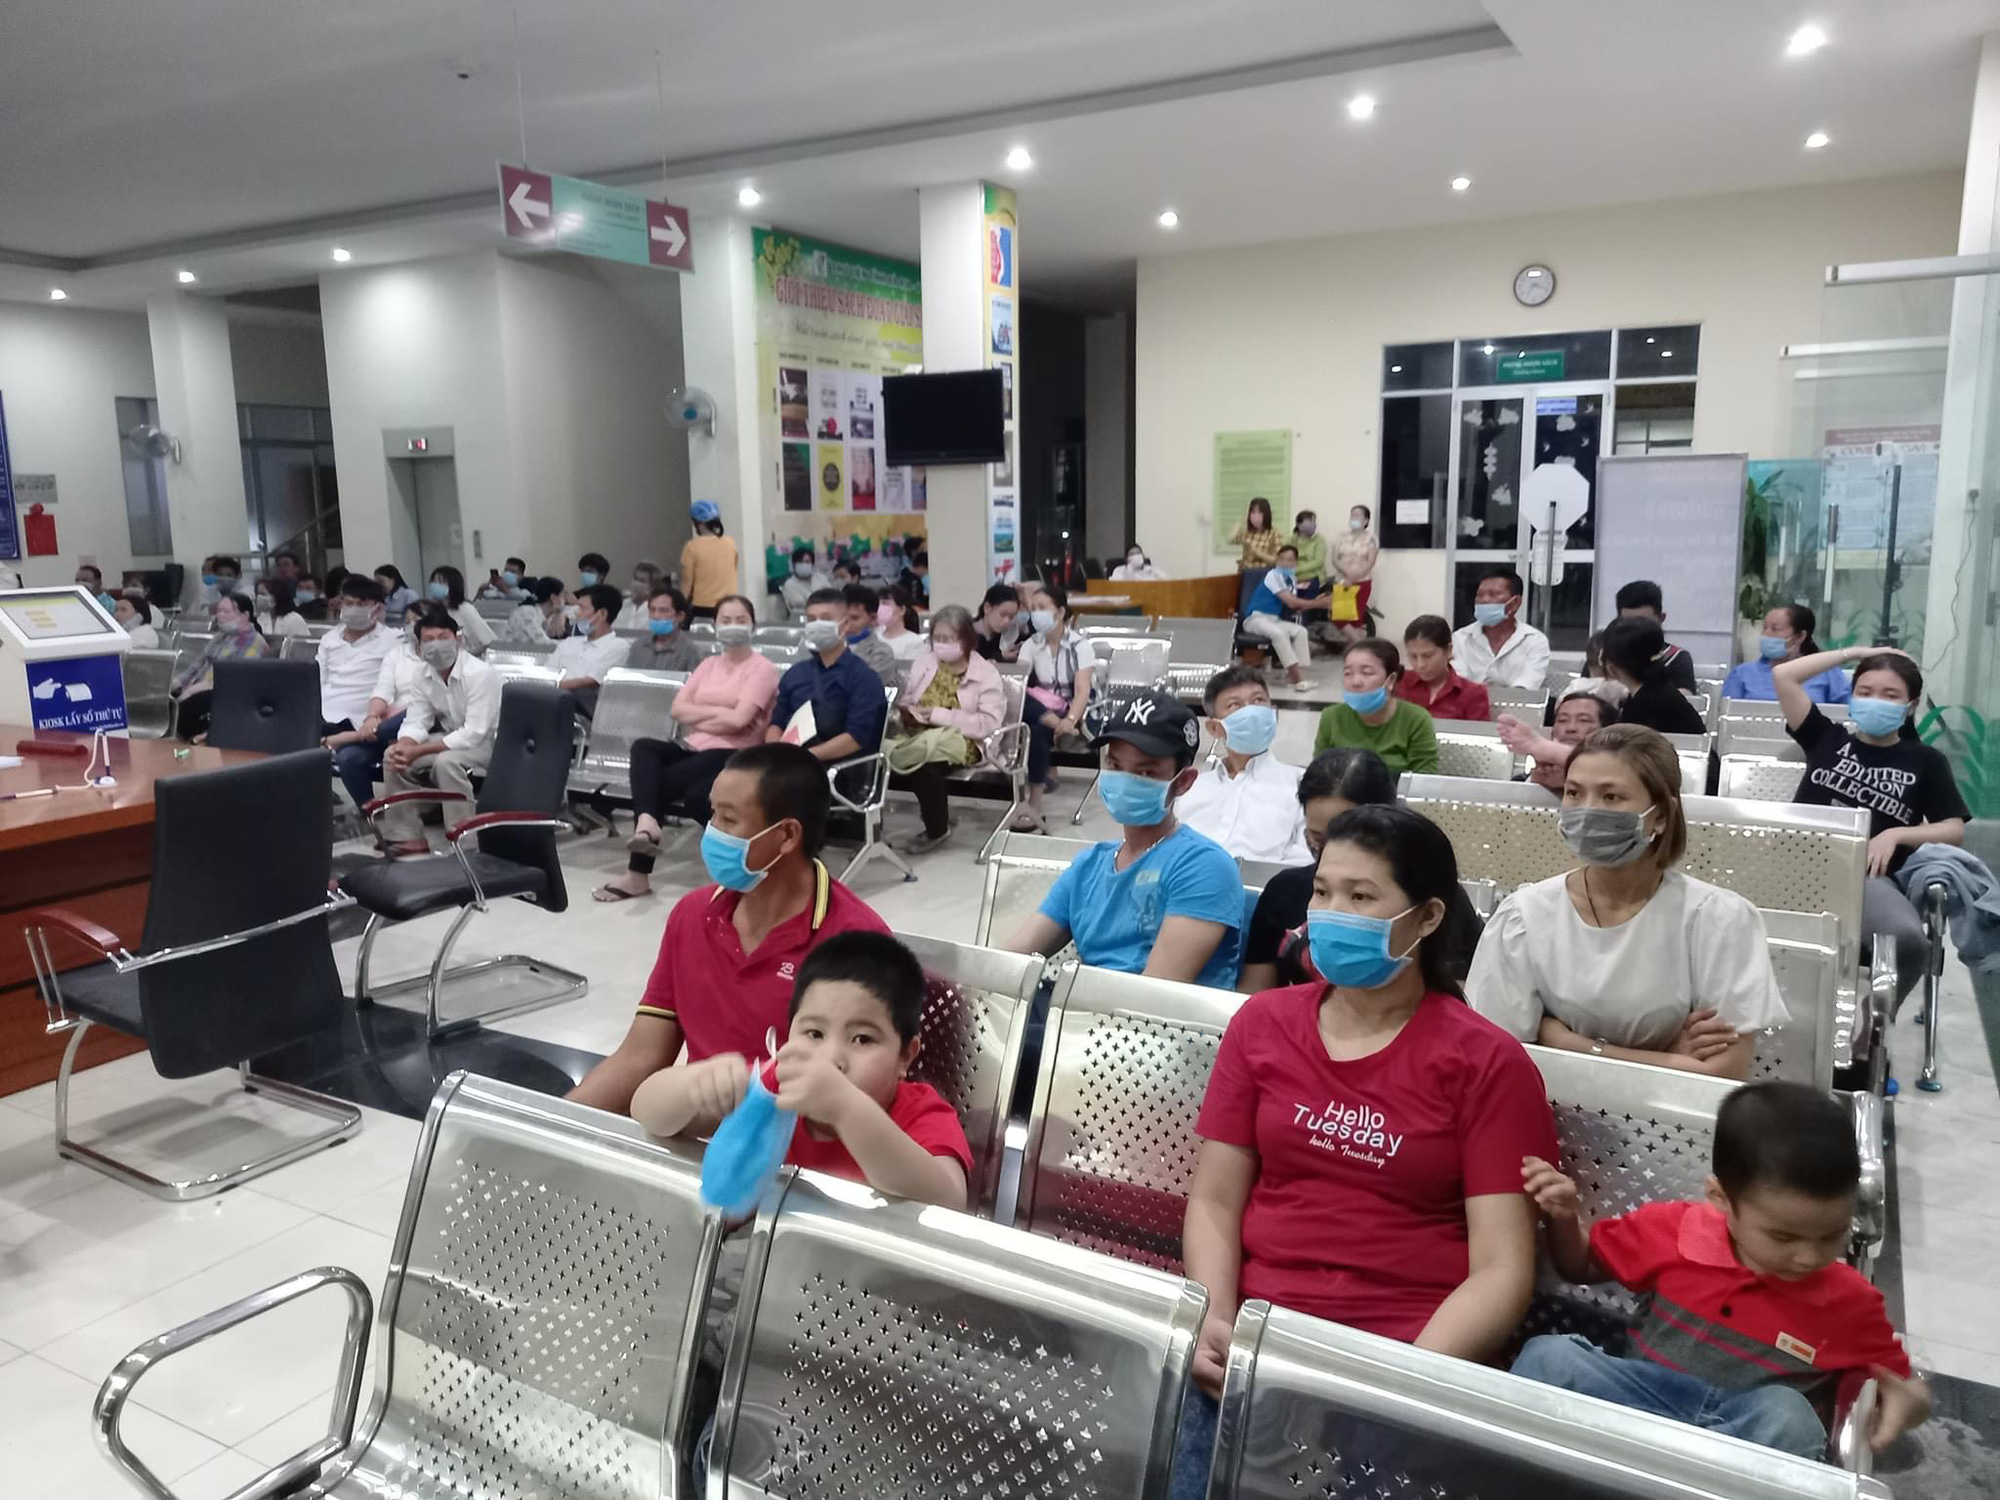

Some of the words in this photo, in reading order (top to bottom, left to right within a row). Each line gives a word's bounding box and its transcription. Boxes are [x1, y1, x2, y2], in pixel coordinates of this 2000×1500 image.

[39, 717, 64, 729] KIOSK
[1811, 768, 1914, 826] COLLECTIBLE
[1294, 1102, 1403, 1156] Tuesday
[1324, 1100, 1385, 1129] Hello
